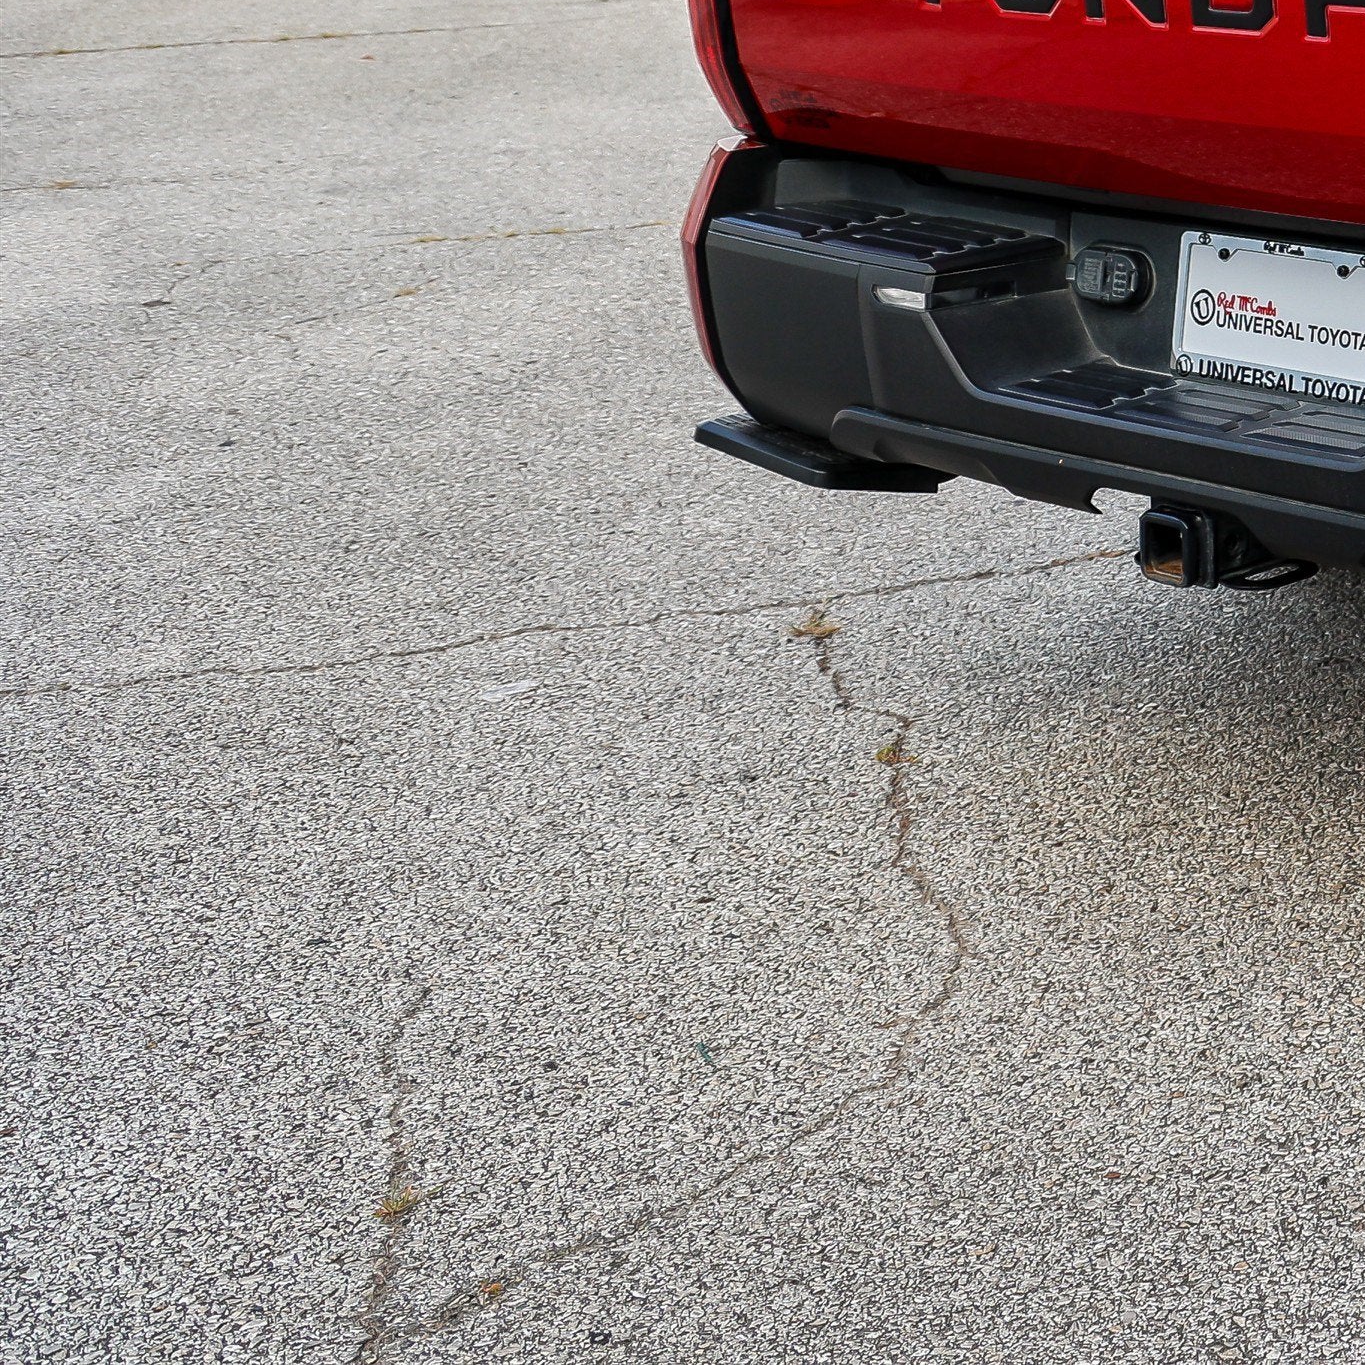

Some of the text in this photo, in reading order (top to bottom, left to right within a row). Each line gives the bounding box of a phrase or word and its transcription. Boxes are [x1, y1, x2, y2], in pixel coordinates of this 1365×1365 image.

[1216, 291, 1277, 317] Red McCombs
[1216, 310, 1305, 341] UNIVERSAL
[1199, 358, 1300, 394] UNIVERSAL
